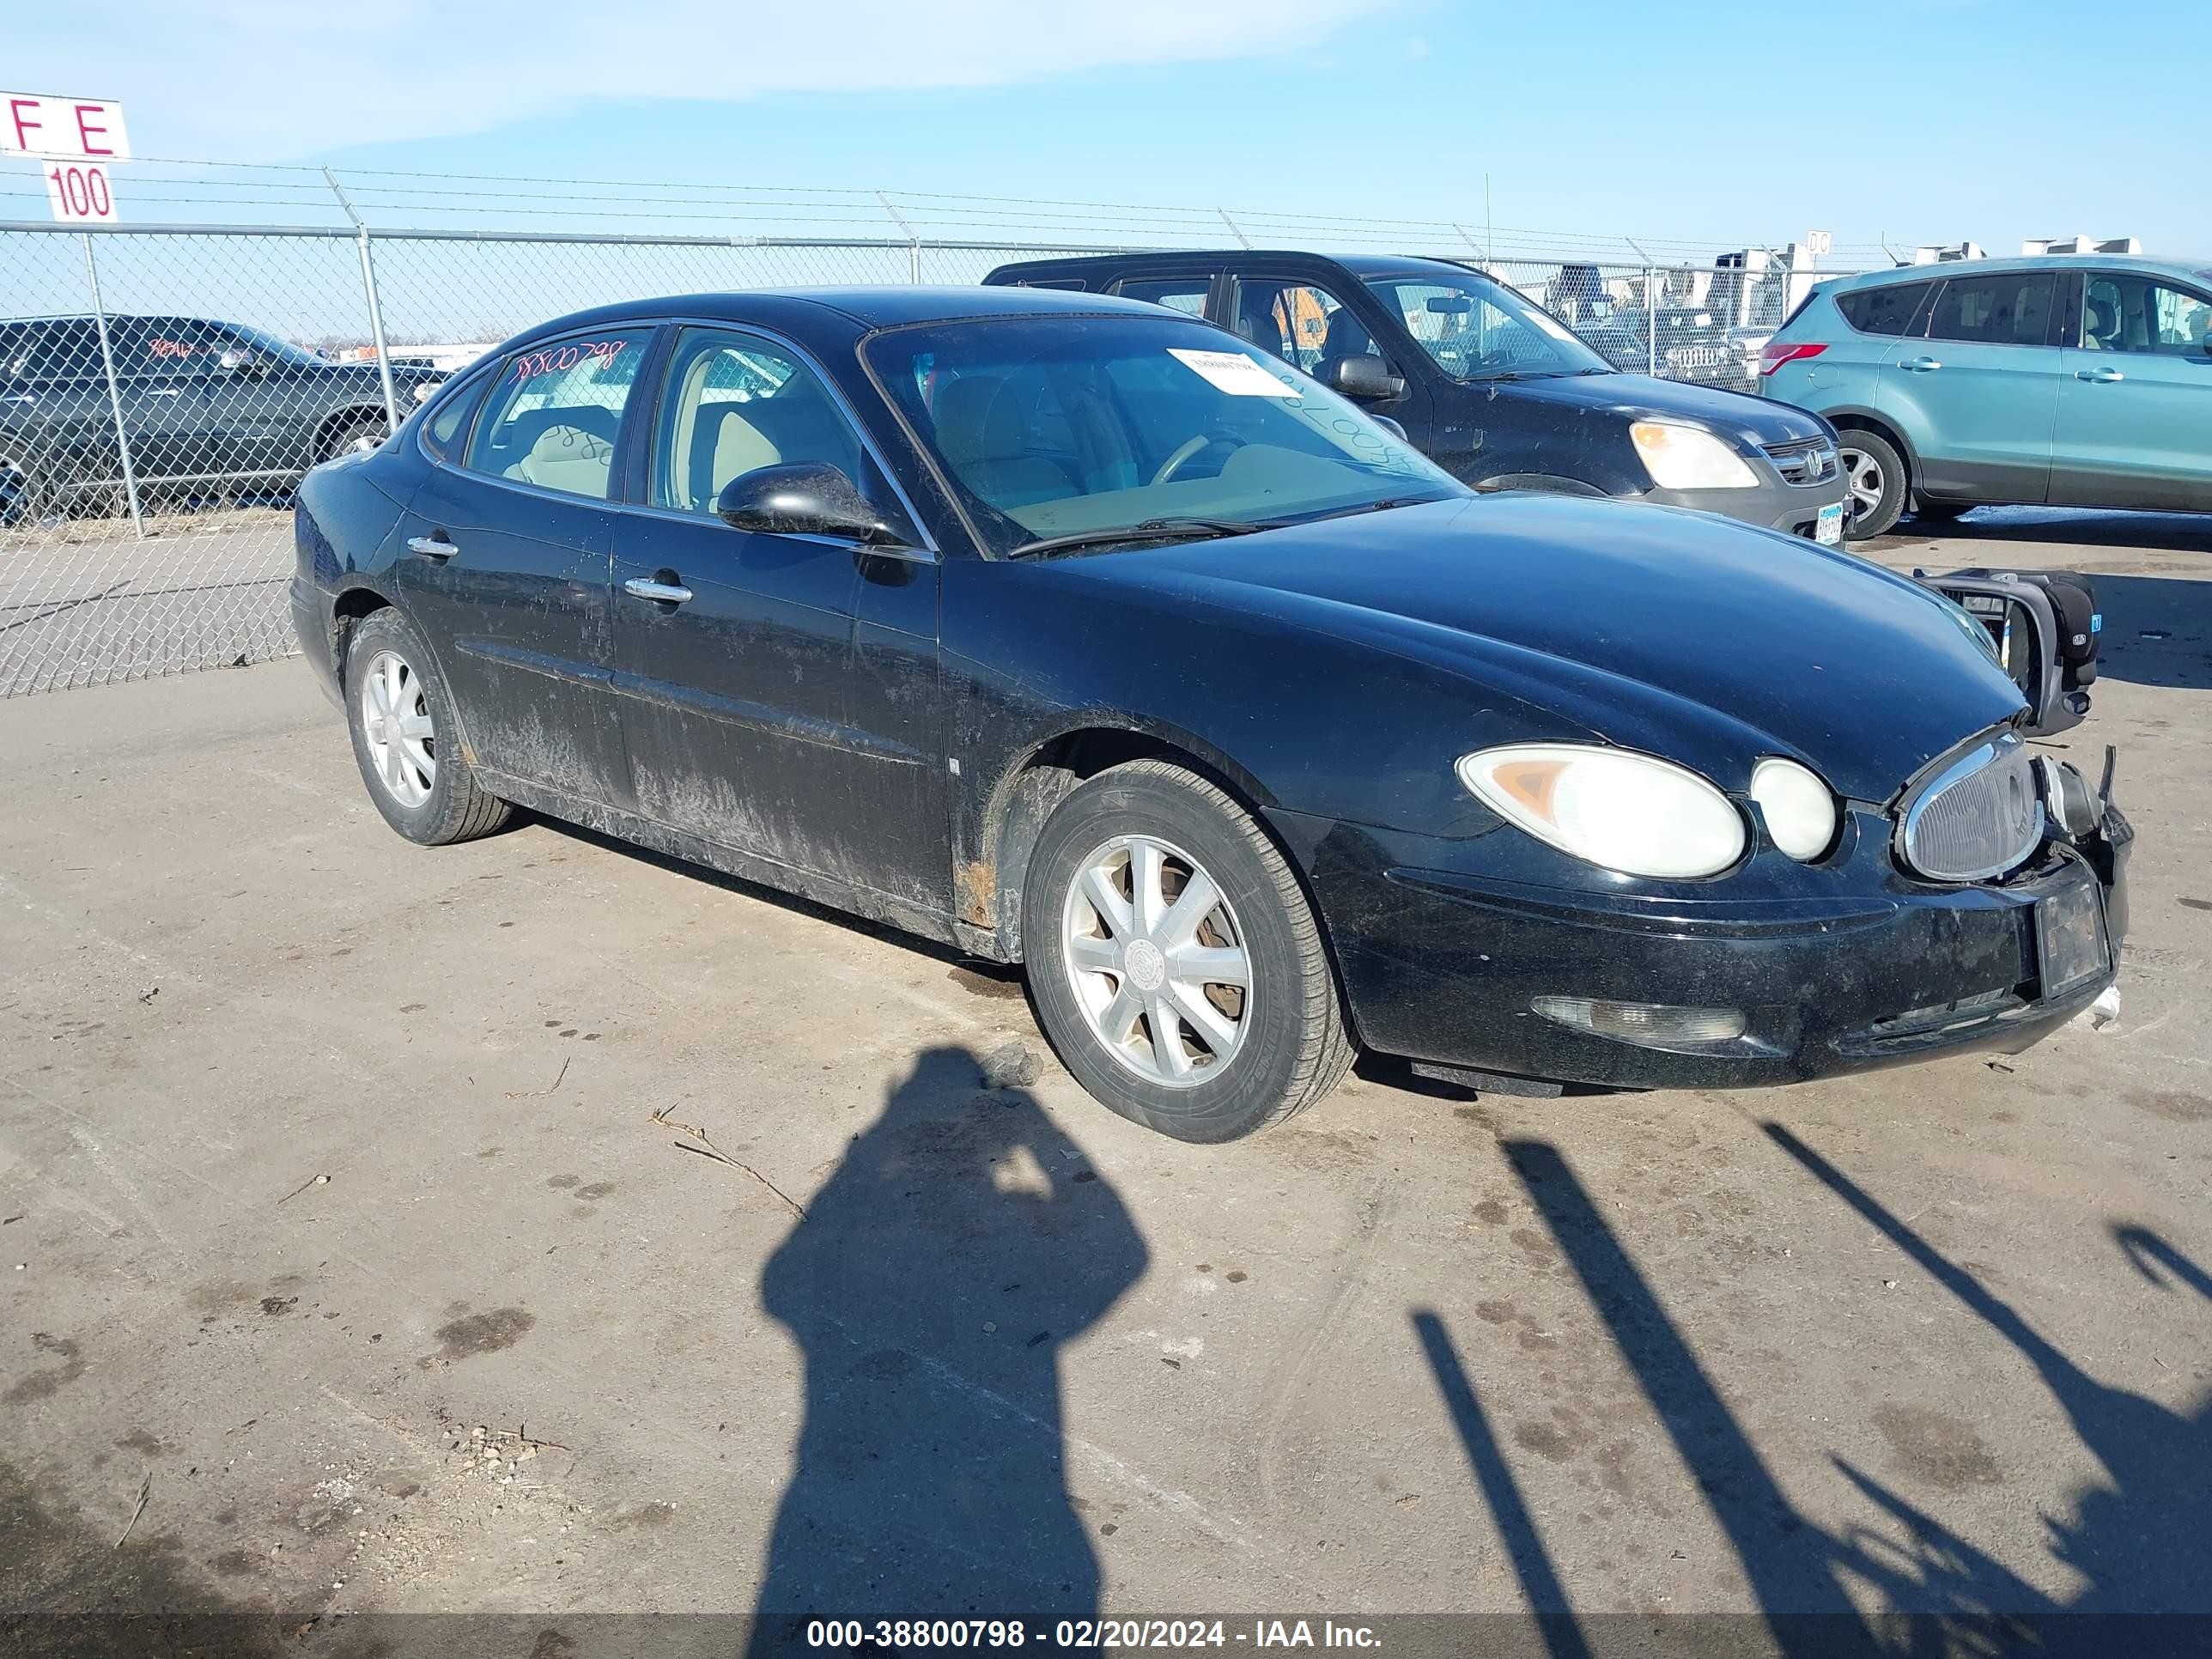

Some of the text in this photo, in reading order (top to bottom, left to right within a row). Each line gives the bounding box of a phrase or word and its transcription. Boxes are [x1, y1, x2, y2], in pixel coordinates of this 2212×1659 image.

[10, 100, 113, 155] F E
[51, 167, 109, 216] 100
[508, 341, 627, 385] 38800798
